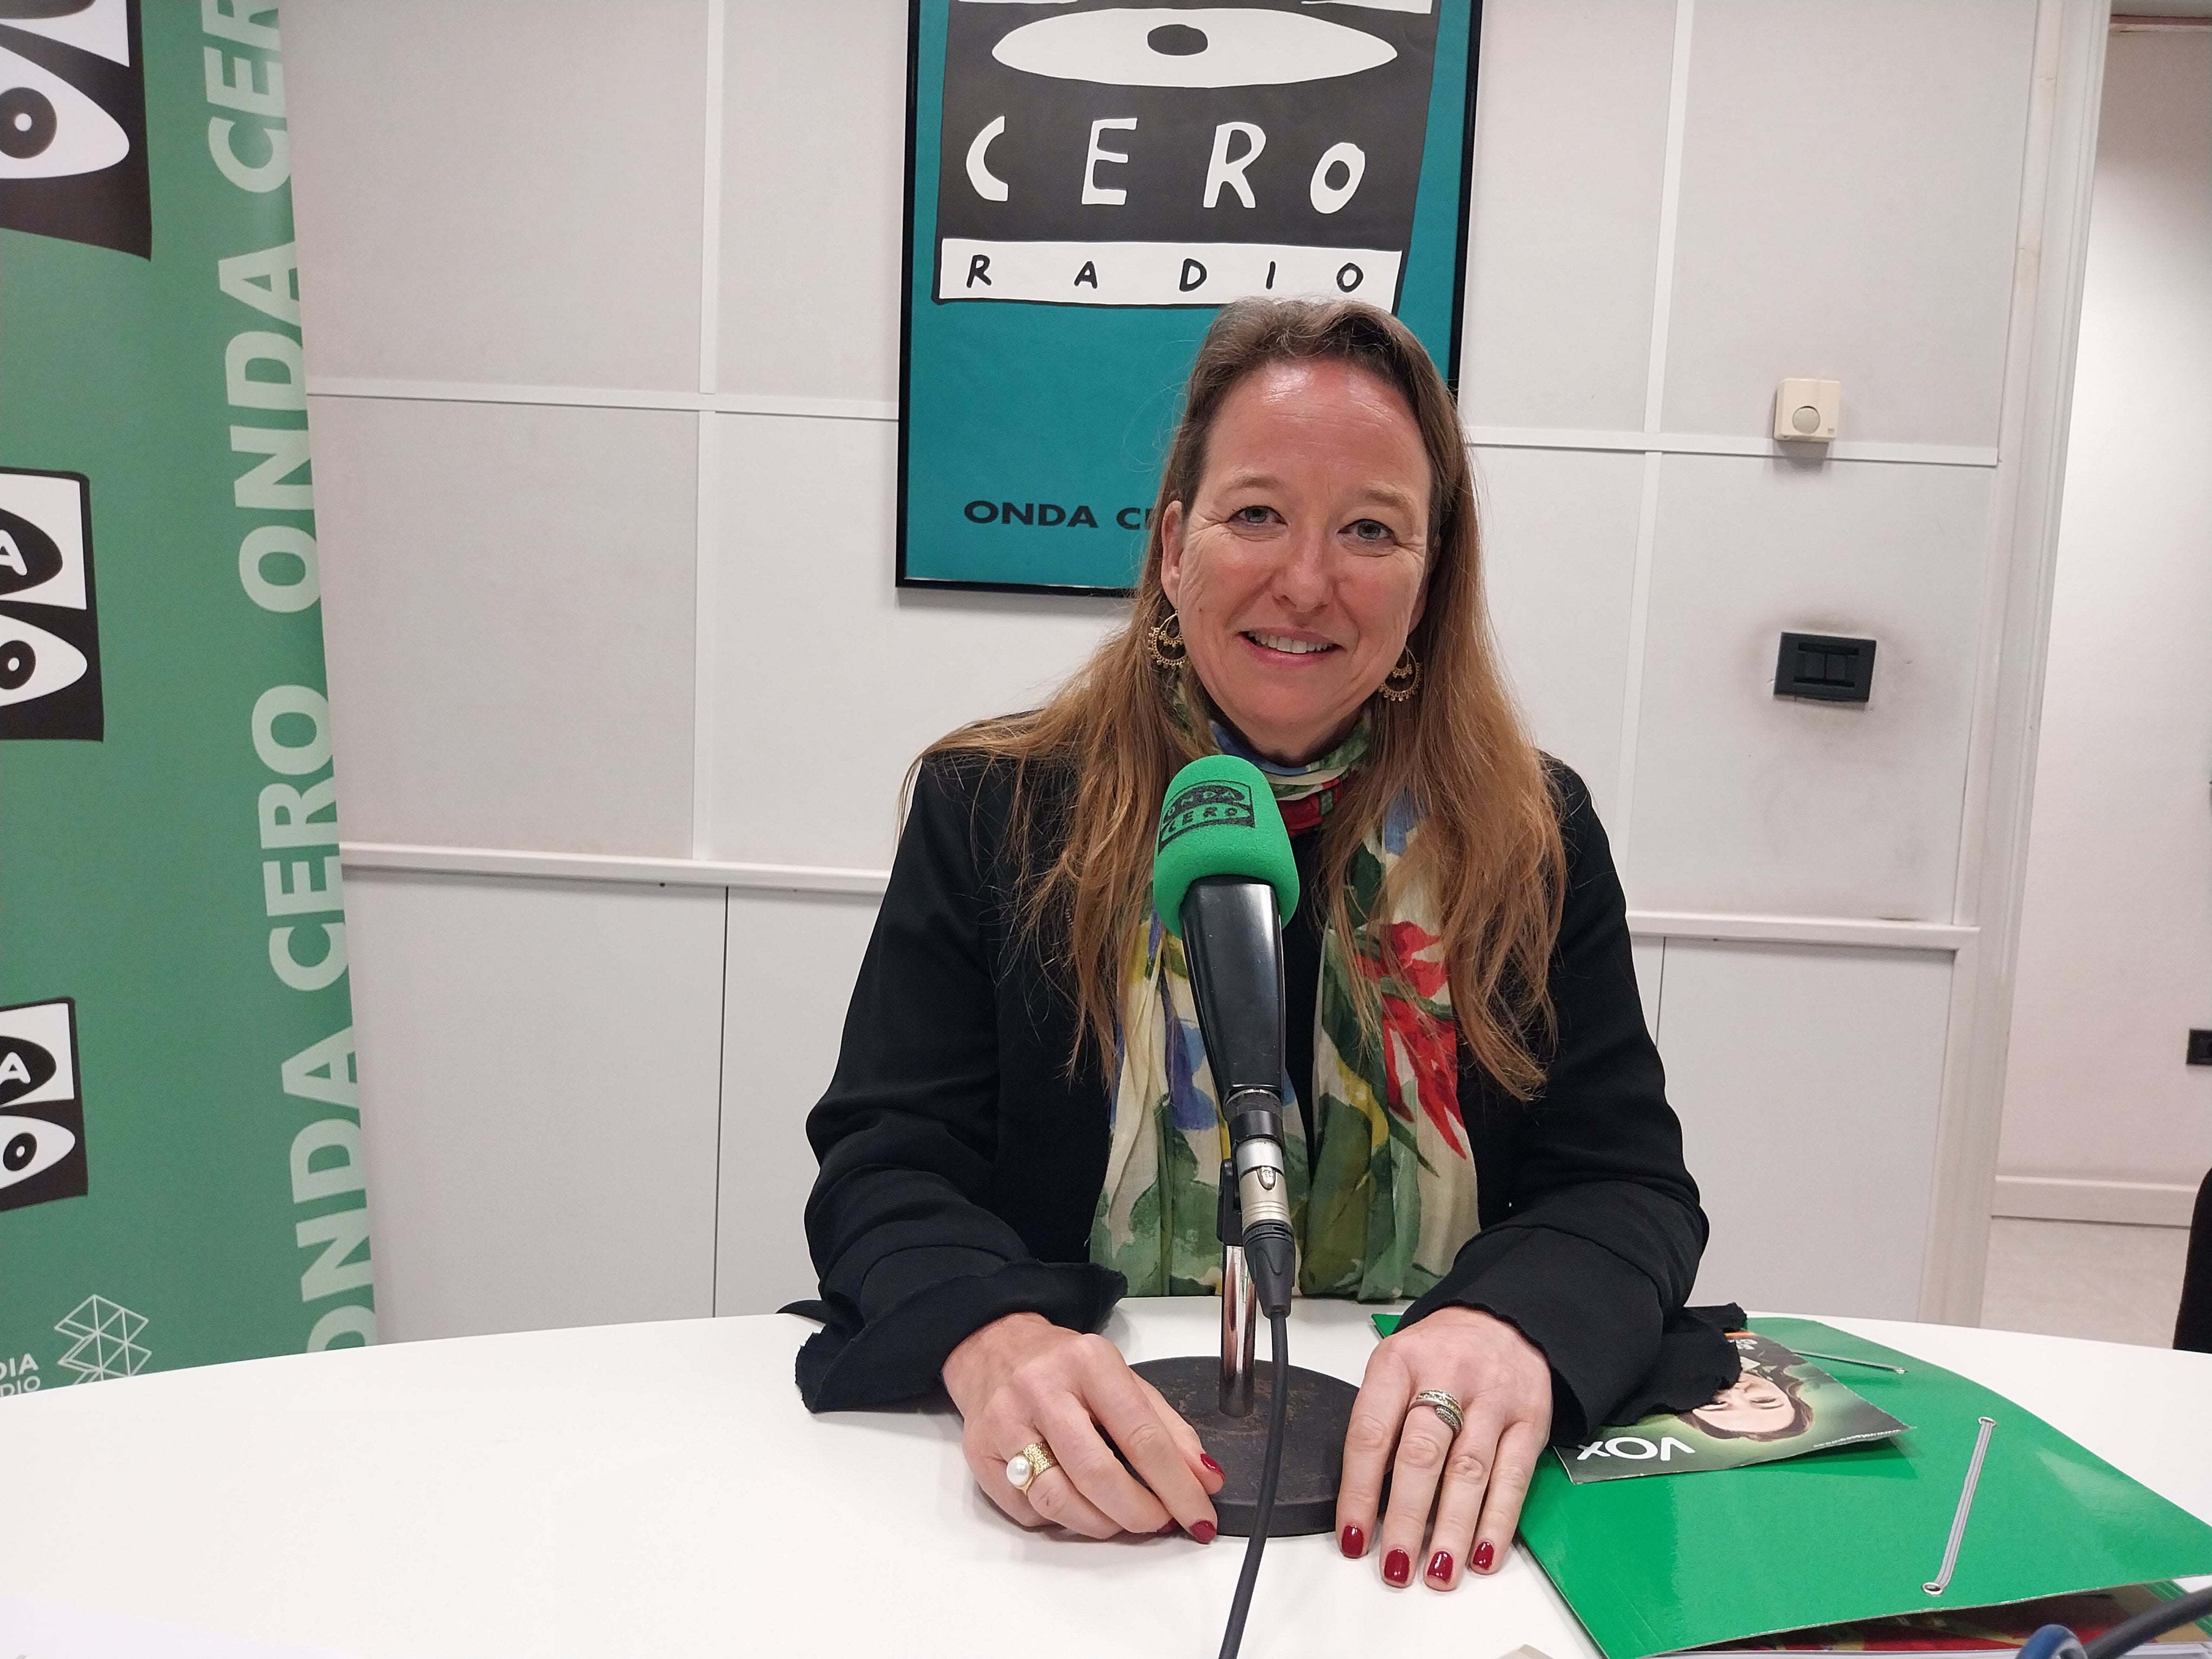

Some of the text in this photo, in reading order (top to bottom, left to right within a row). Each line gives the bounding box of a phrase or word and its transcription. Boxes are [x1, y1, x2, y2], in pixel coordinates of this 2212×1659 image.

[966, 115, 1365, 214] CERO
[966, 254, 1364, 292] RADIO
[218, 241, 321, 613] ONDA
[964, 500, 1098, 529] ONDA
[251, 684, 349, 992] CERO
[1168, 806, 1238, 833] CERO
[1577, 1436, 1696, 1461] VOX
